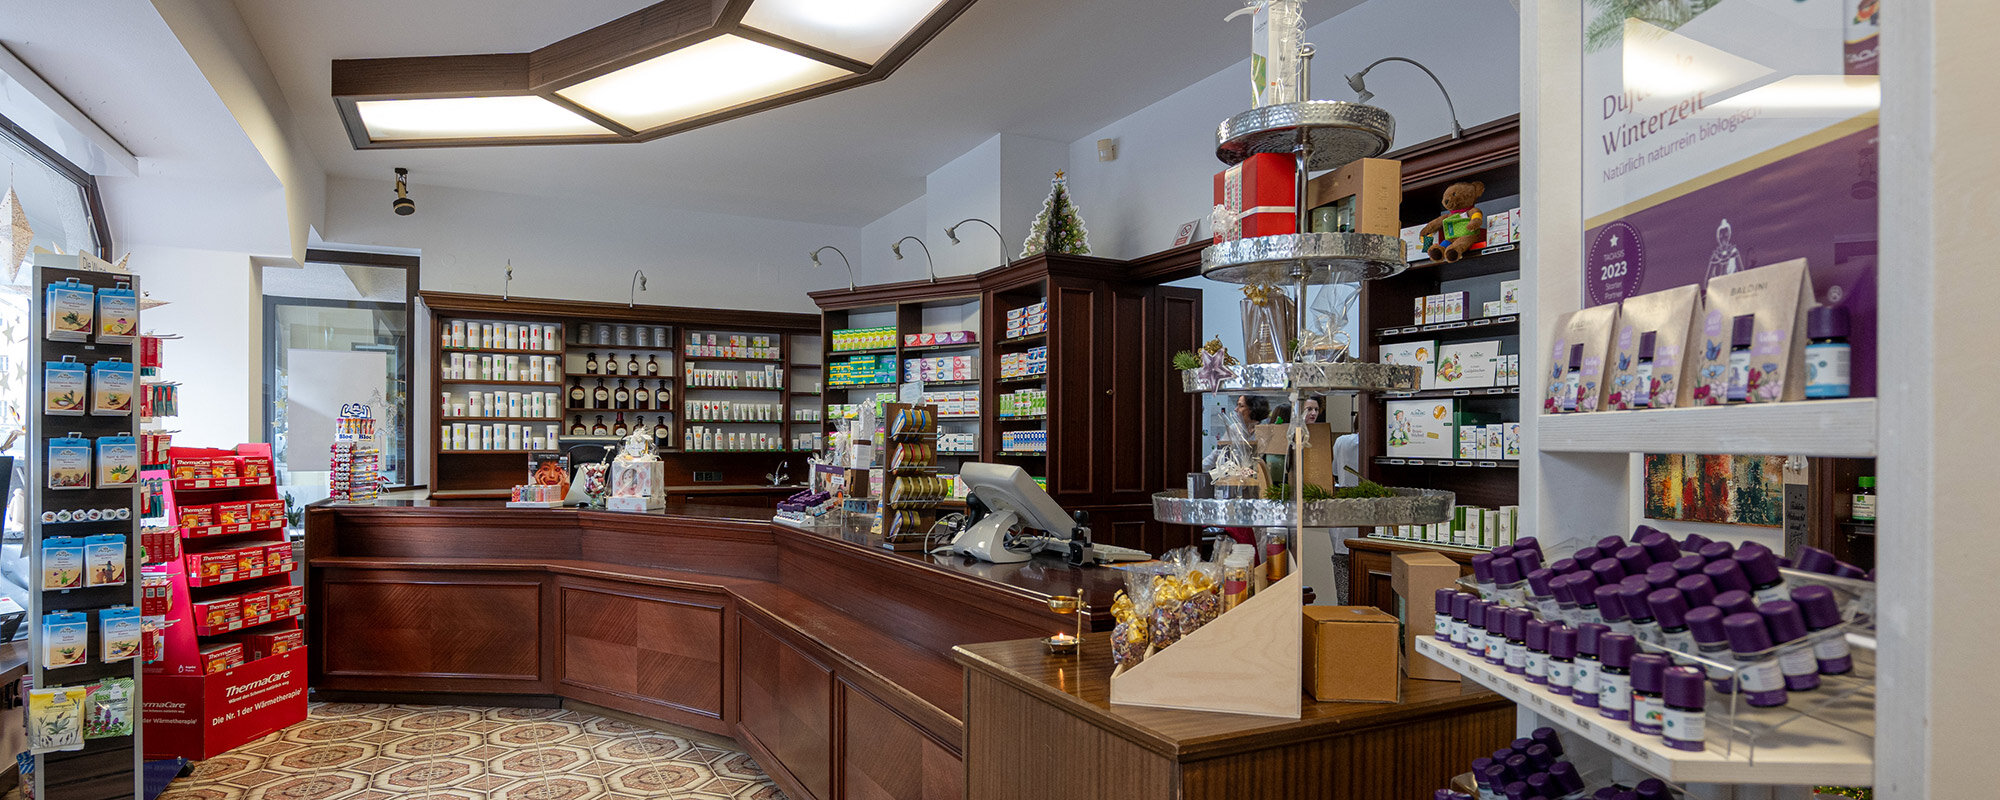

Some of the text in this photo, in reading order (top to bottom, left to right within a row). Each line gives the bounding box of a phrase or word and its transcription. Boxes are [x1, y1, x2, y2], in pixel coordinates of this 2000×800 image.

[1602, 90, 1706, 156] Winterzeit
[1603, 106, 1763, 183] Natürlich naturrein biologisch
[1601, 260, 1628, 280] 2023
[1730, 282, 1768, 296] BALDINI
[226, 670, 290, 698] ThermaCare
[212, 716, 224, 727] Die
[226, 712, 236, 721] Nr.
[241, 706, 253, 715] der
